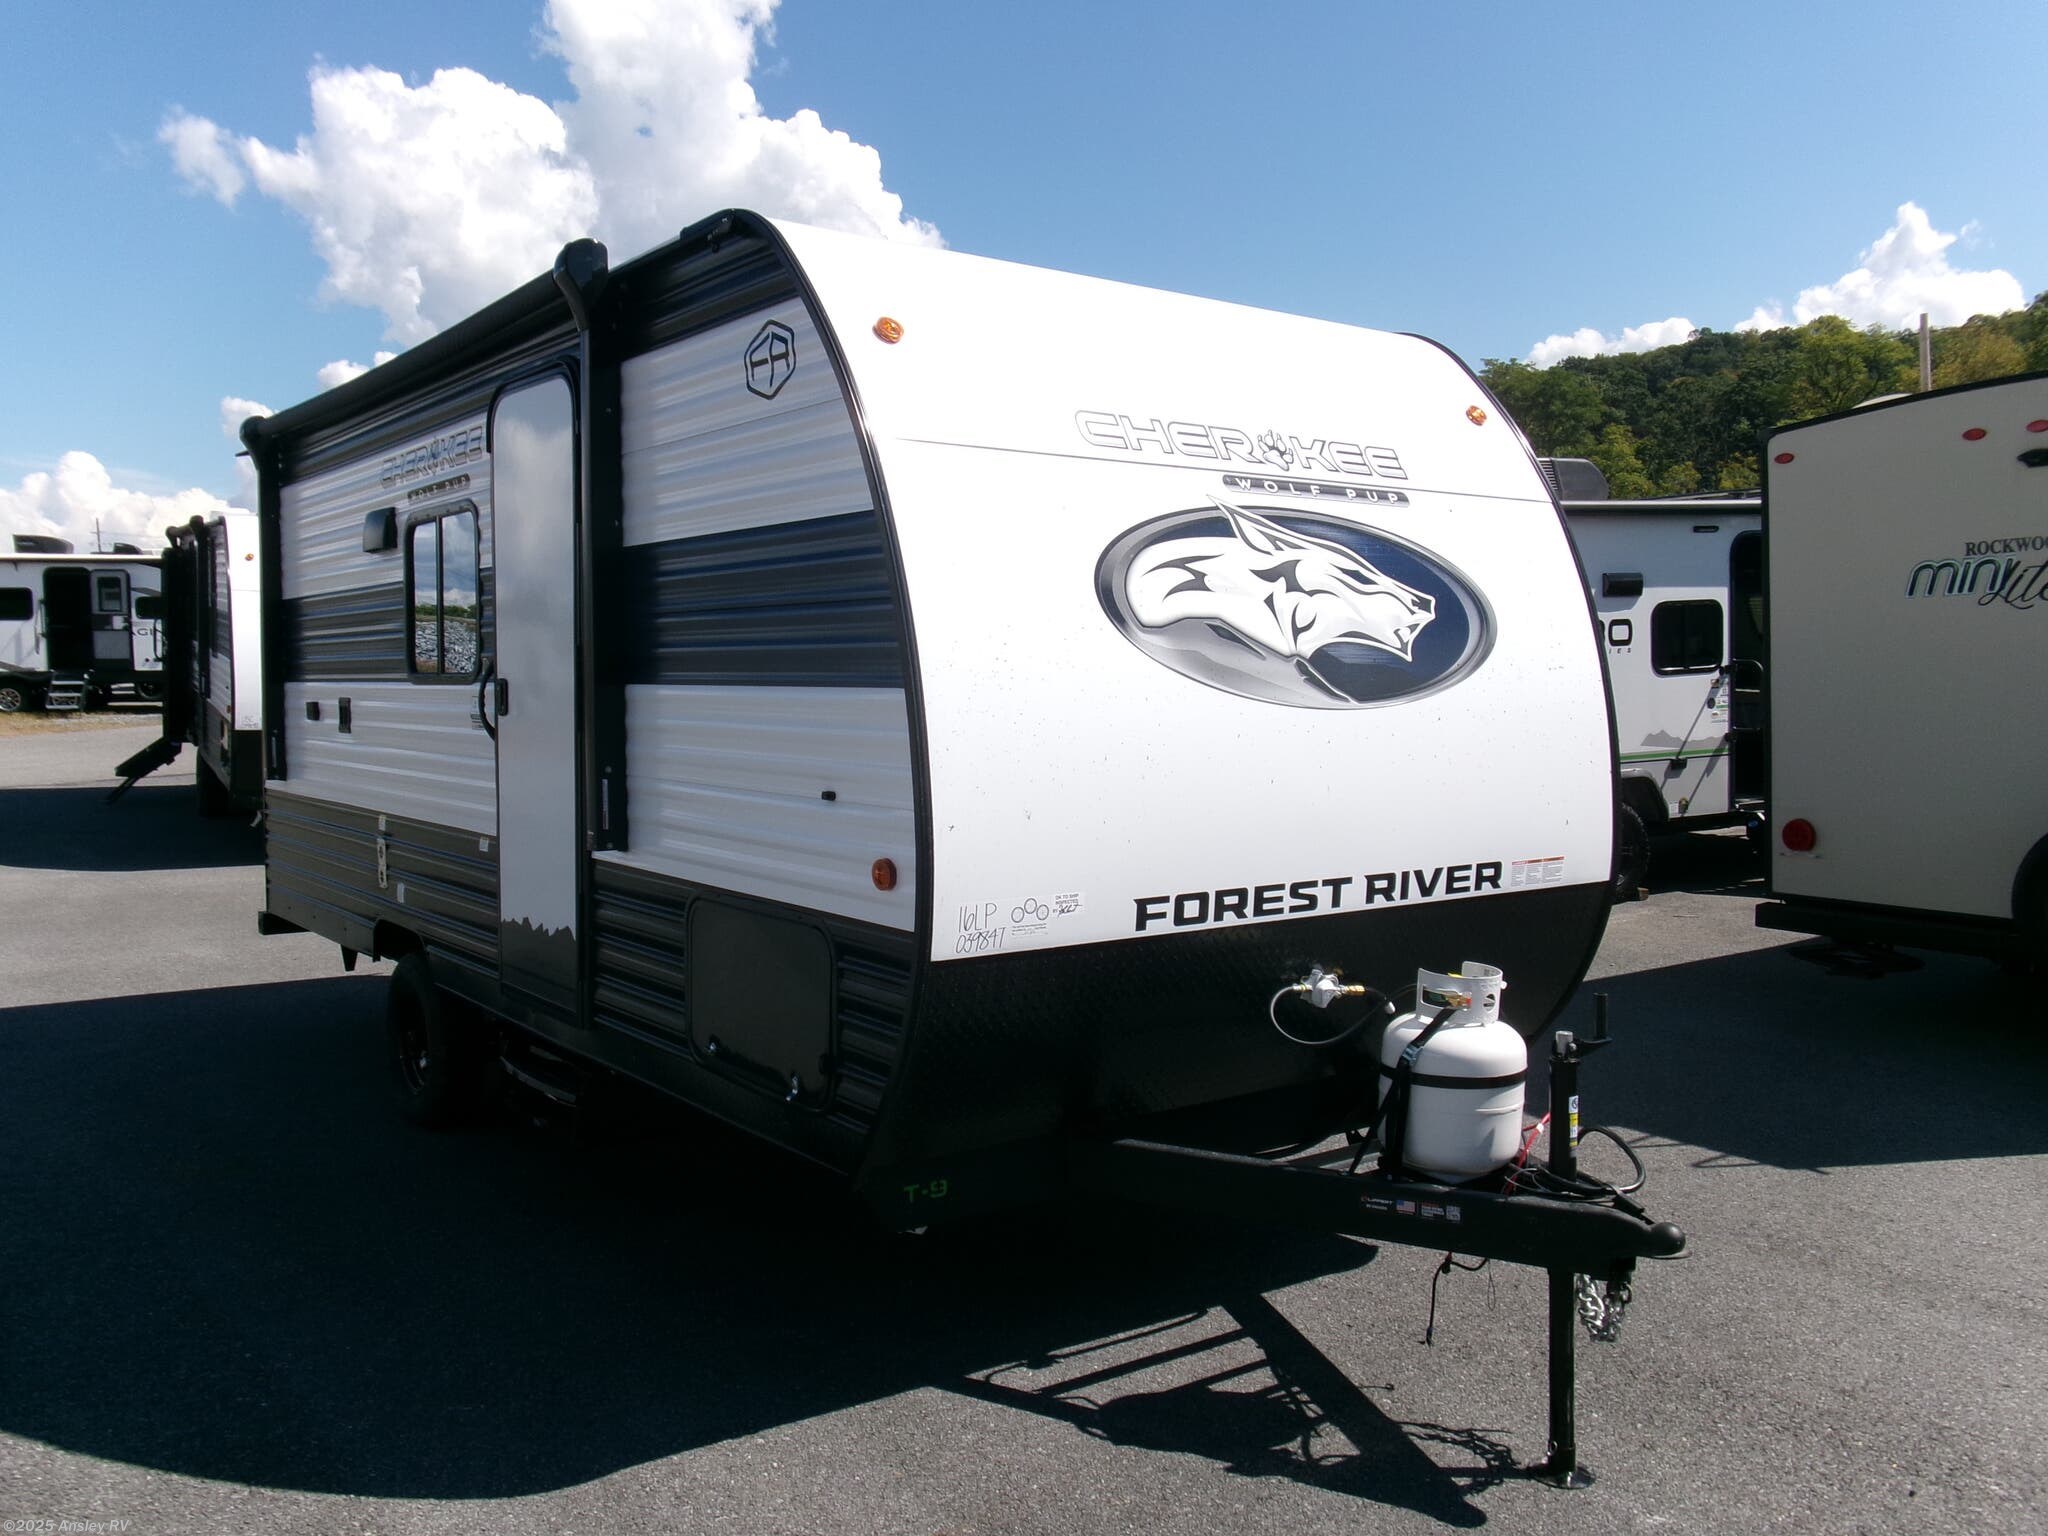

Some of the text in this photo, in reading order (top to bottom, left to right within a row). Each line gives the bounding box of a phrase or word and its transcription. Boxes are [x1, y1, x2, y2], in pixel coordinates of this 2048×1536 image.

[1234, 477, 1400, 504] WOLF PUP
[1965, 535, 2048, 556] ROCKWO
[1134, 876, 1354, 932] FOREST
[1364, 860, 1504, 905] RIVER
